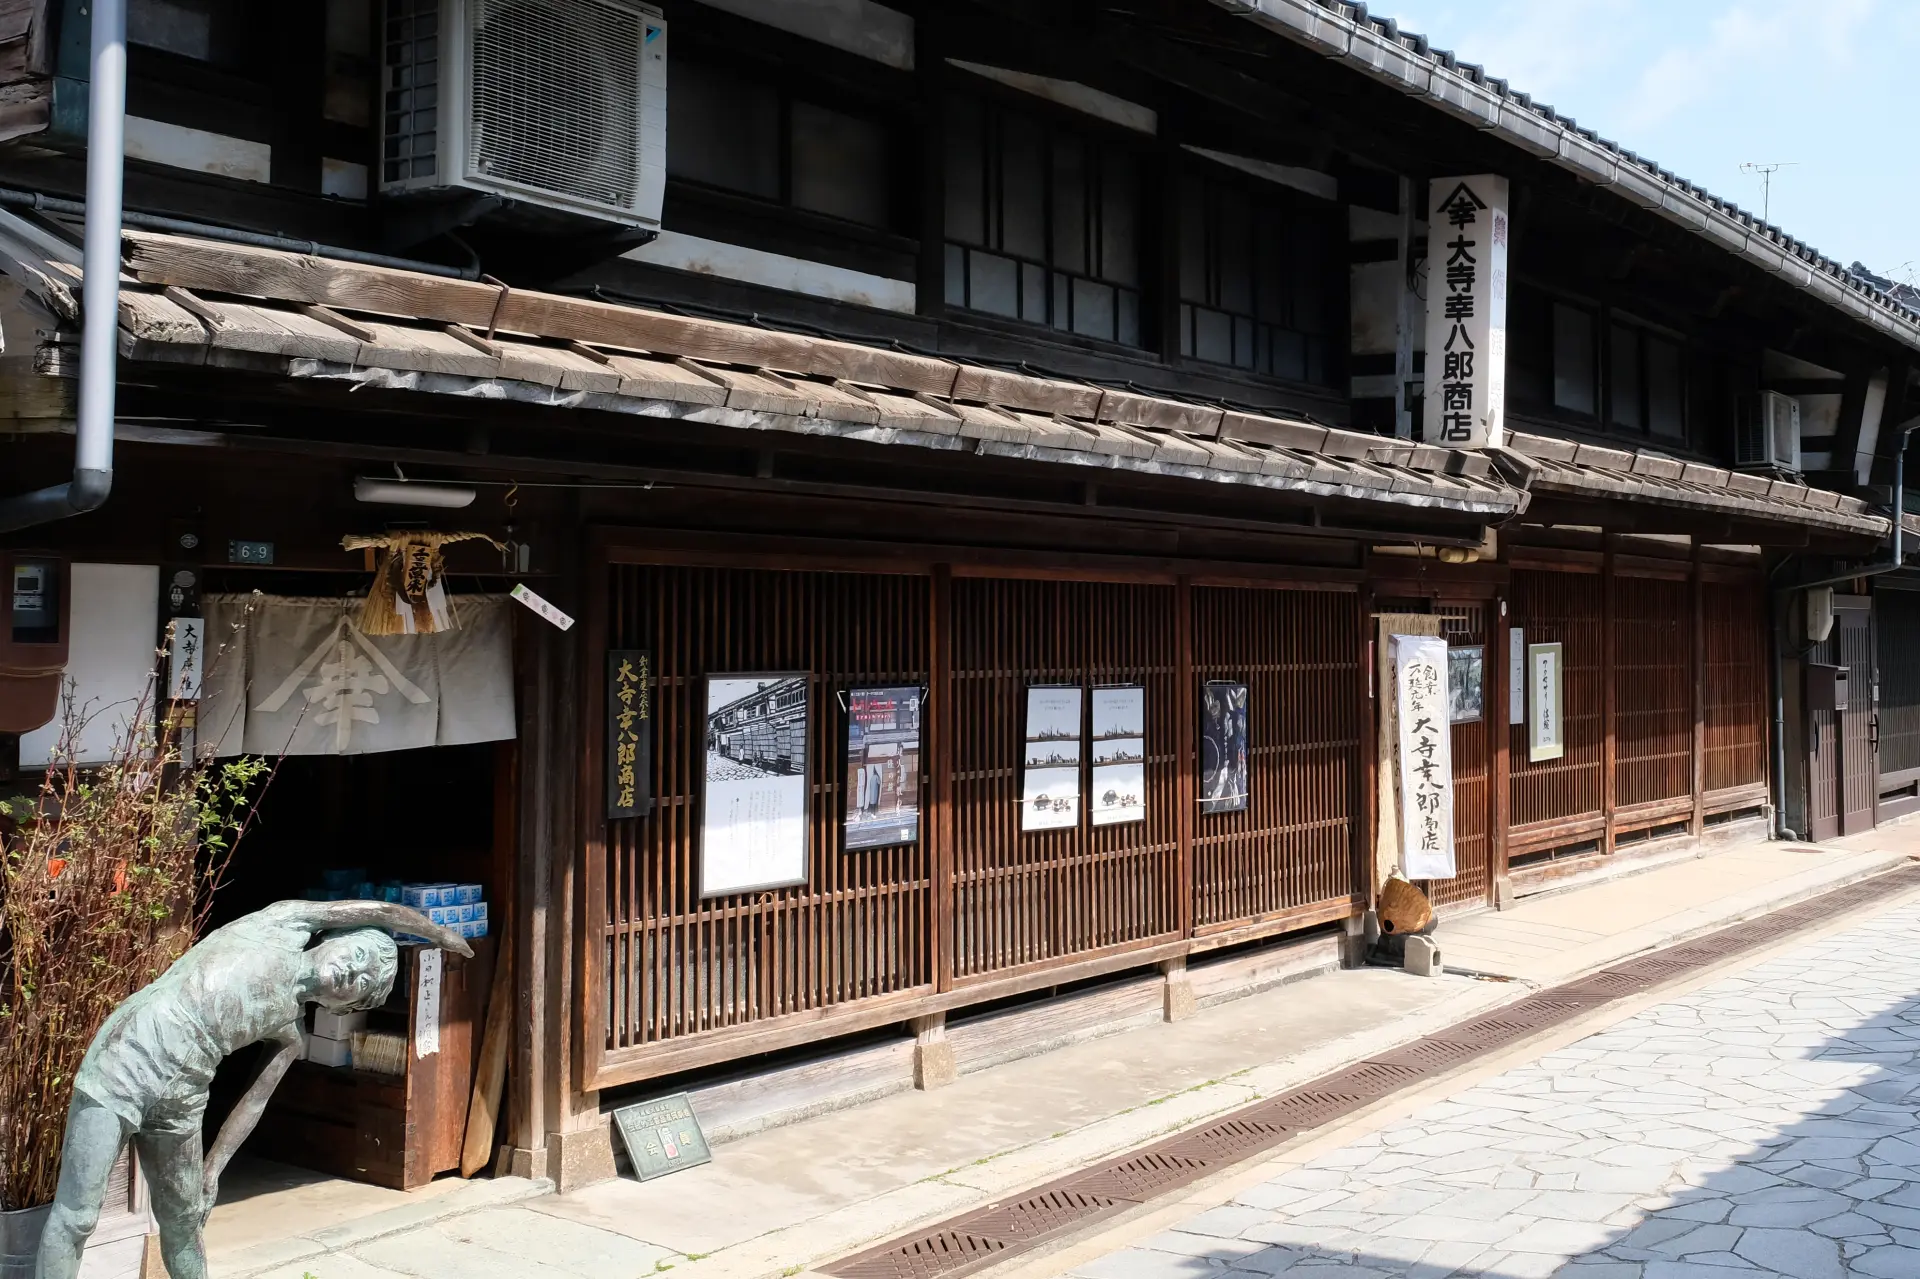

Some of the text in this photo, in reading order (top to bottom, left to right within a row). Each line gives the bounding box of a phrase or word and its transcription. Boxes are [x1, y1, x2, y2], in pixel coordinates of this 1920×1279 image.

[1440, 234, 1477, 442] 大寺幸八郎商店
[241, 545, 267, 559] 6-9
[616, 658, 639, 808] 大寺幸八郎商店
[1422, 665, 1438, 697] 創業
[1411, 717, 1444, 851] 大寺幸八郎商店
